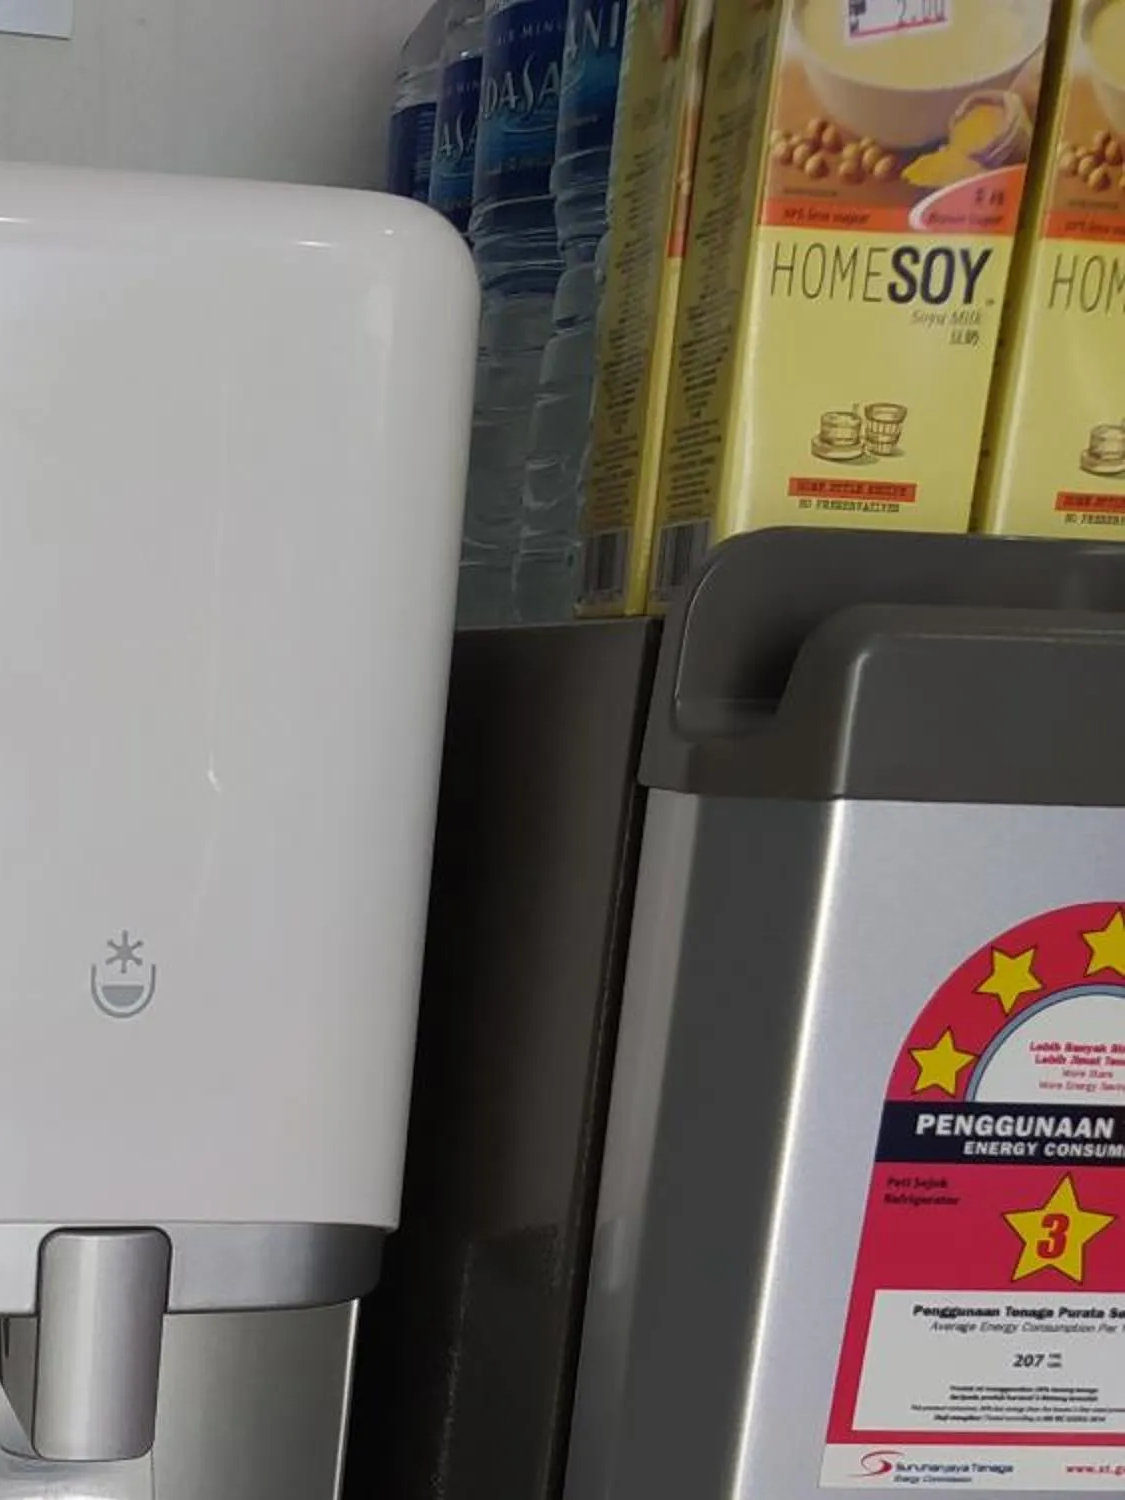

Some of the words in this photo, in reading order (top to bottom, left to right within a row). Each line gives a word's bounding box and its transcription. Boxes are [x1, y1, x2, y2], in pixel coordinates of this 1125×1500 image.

[771, 242, 992, 305] HOMESOY
[915, 1114, 1115, 1139] PENGGUNAAN
[963, 1141, 1039, 1156] ENERGY
[1043, 1142, 1125, 1158] CONSUM
[1036, 1213, 1070, 1259] 3
[913, 1305, 1000, 1319] Penggunaan
[1005, 1306, 1054, 1320] Tenaga
[1059, 1306, 1105, 1318] Purata
[1013, 1354, 1044, 1368] 207
